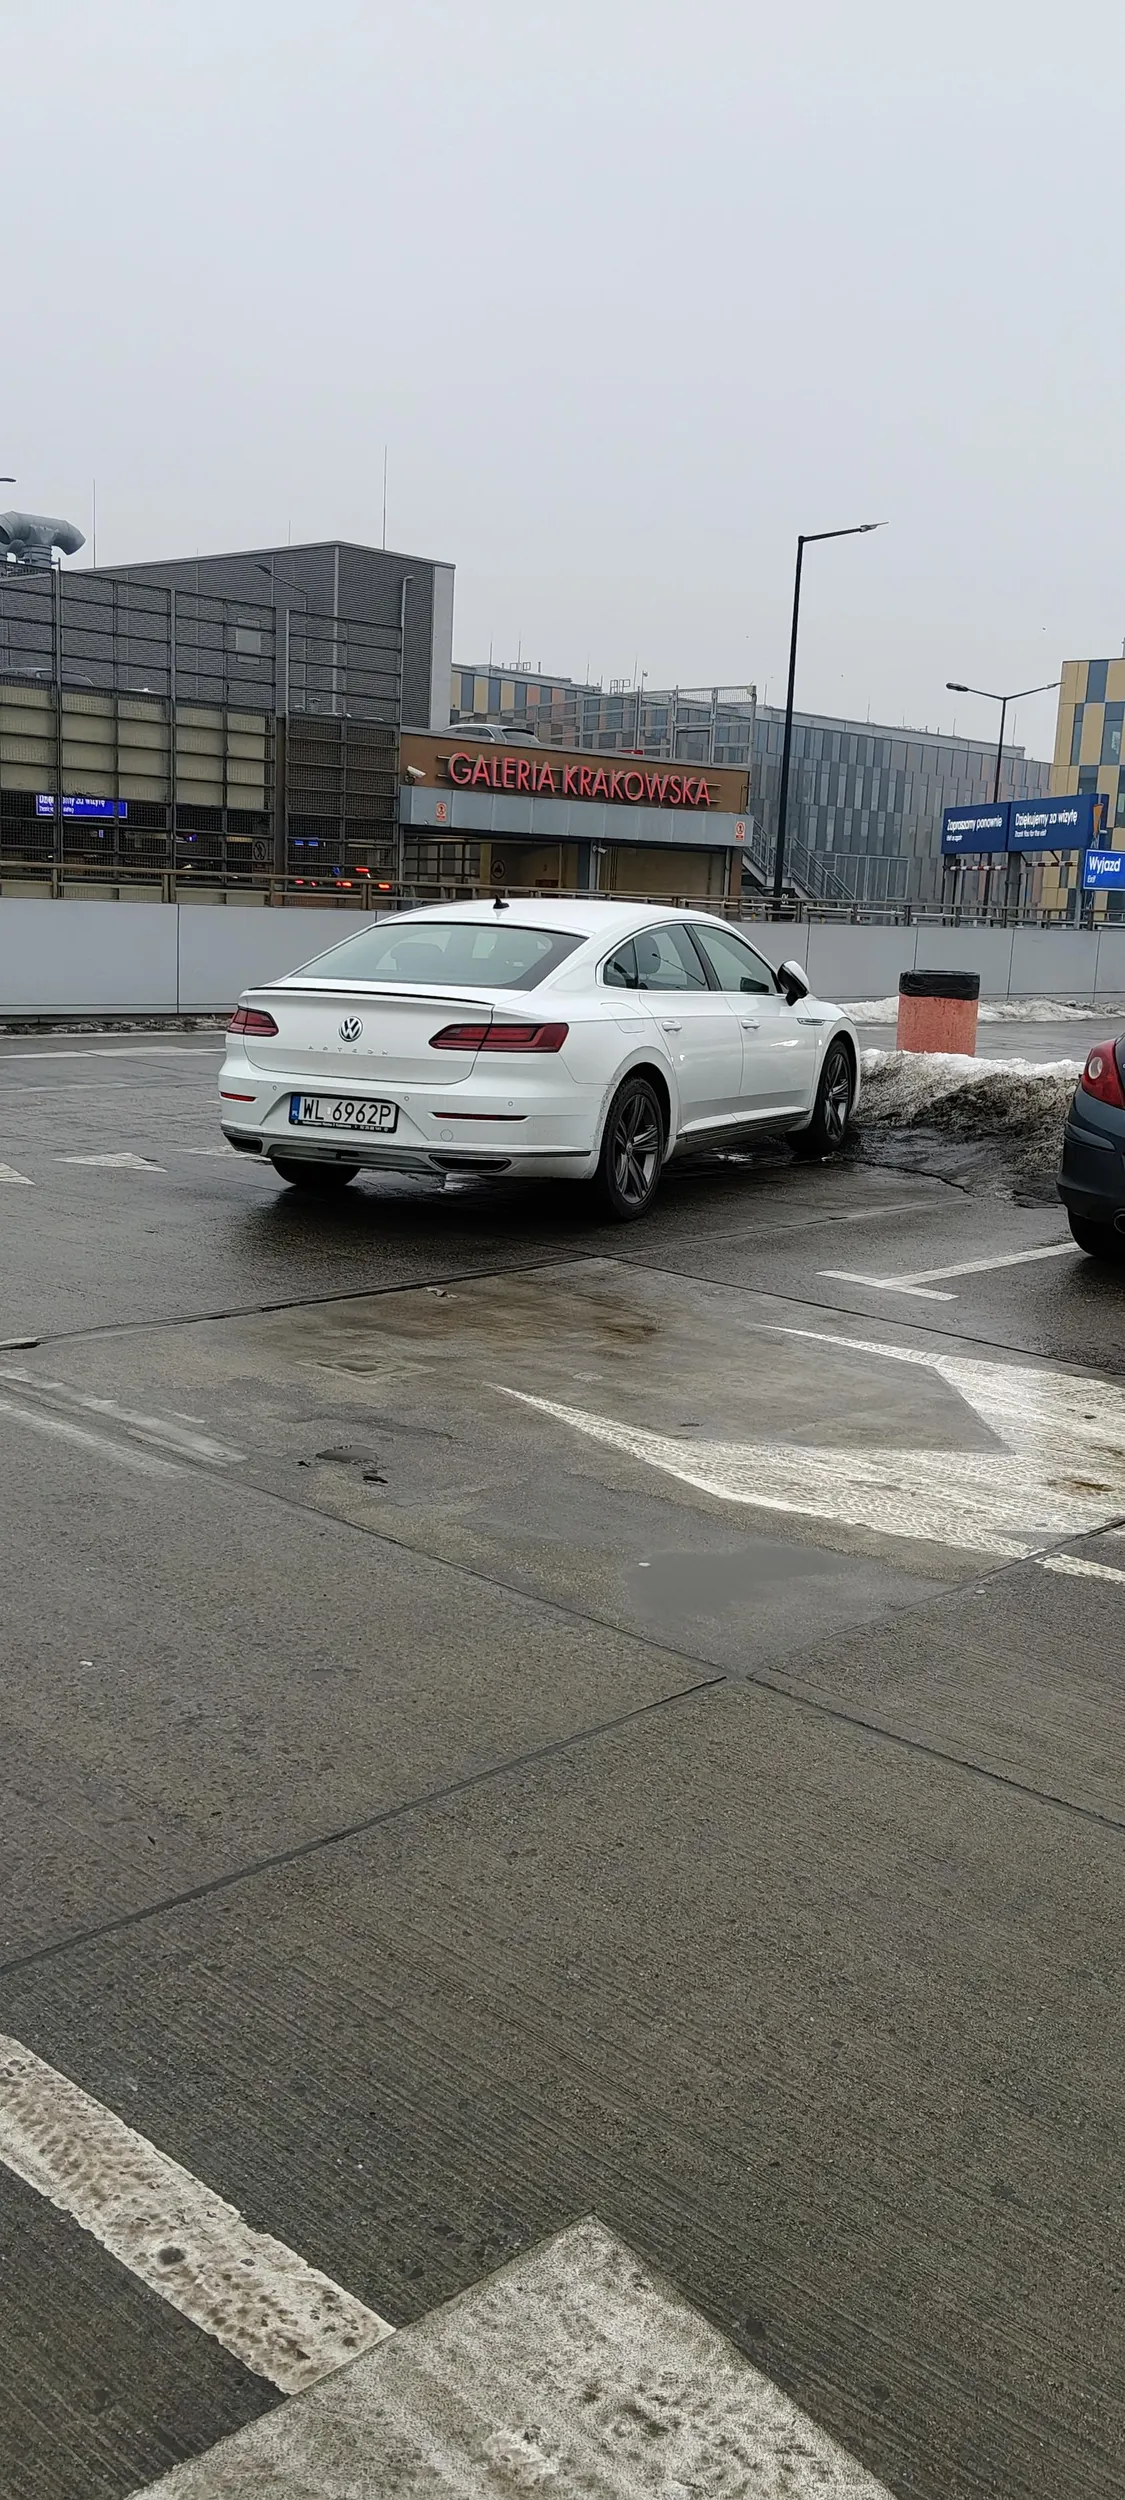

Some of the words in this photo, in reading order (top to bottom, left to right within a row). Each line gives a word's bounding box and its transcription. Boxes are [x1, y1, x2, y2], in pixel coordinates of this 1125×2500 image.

[448, 752, 555, 793] GALERIA
[563, 763, 711, 806] KRAKOWSKA
[1015, 812, 1048, 828] Dziękujemy
[1049, 813, 1057, 824] za
[1058, 808, 1078, 826] wizytę
[1089, 855, 1121, 875] Wyjazd
[303, 1098, 324, 1120] WL
[332, 1102, 391, 1125] 6962P
